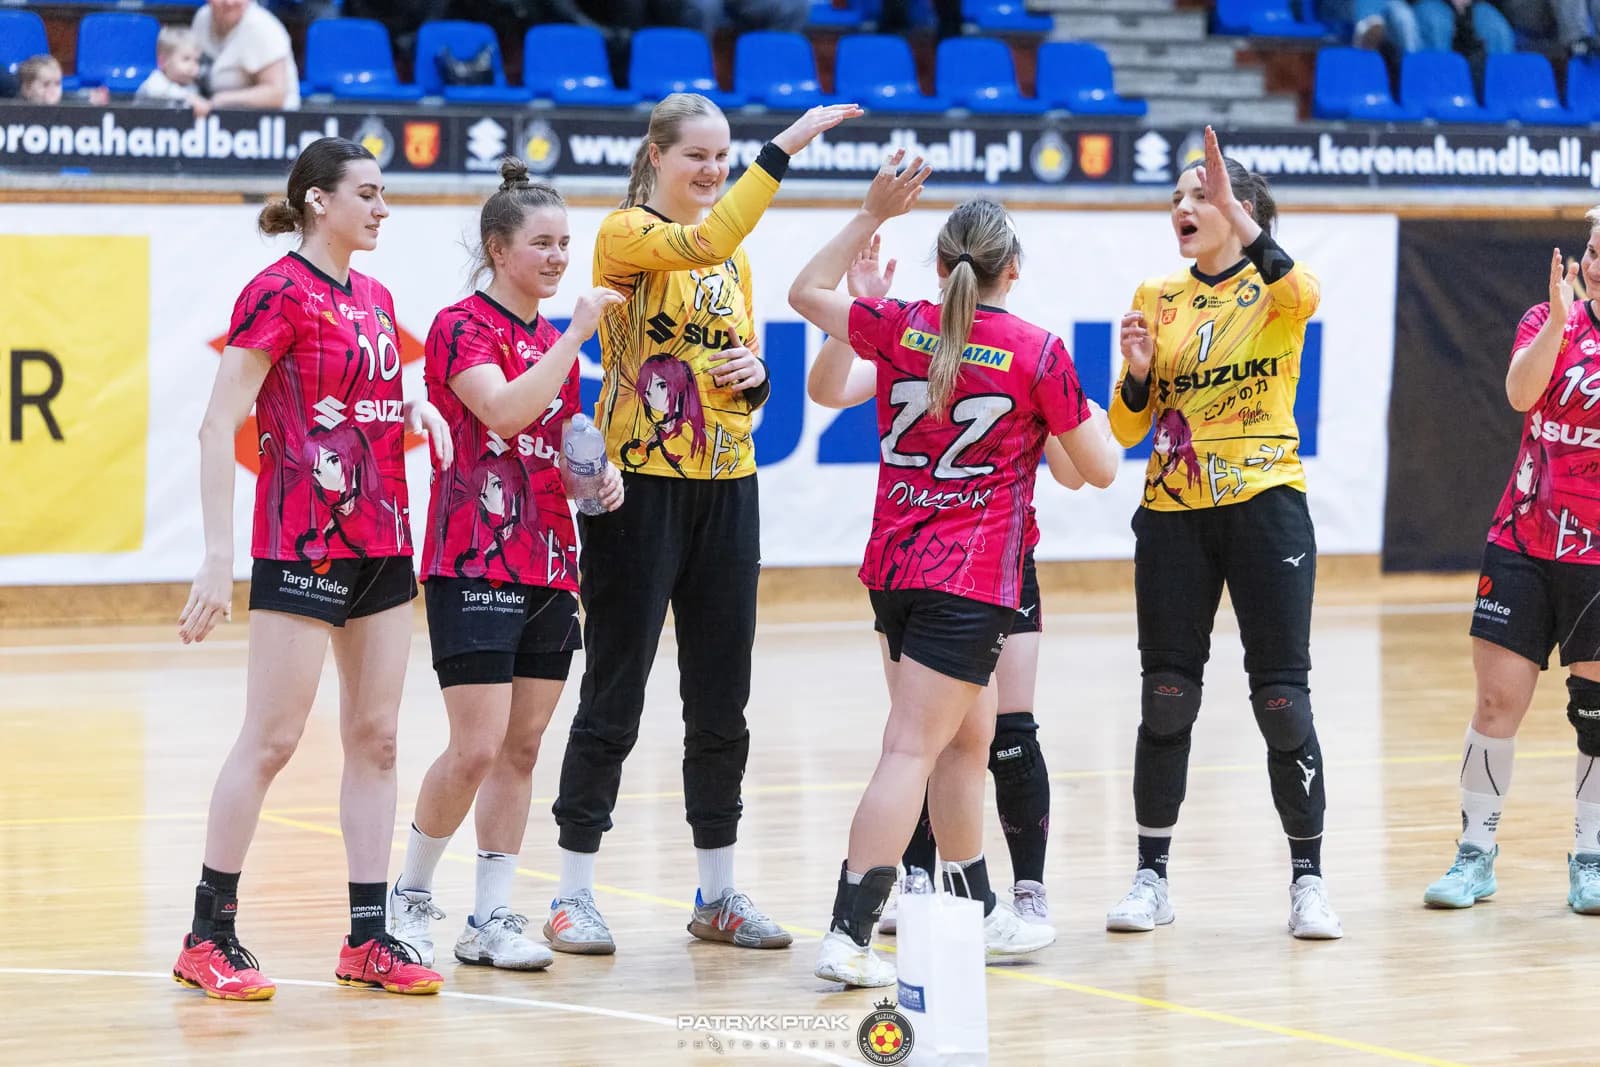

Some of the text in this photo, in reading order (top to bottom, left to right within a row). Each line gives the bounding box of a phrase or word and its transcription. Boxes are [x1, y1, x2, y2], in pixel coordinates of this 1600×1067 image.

[690, 269, 734, 316] 12
[357, 332, 401, 381] 10
[1196, 319, 1216, 363] 1
[1174, 358, 1278, 393] SUZUKI
[880, 378, 1016, 481] 22
[282, 569, 349, 595] Targi Kielce
[461, 590, 493, 604] Targi
[1479, 598, 1511, 616] Kielce
[997, 746, 1022, 758] SELECT
